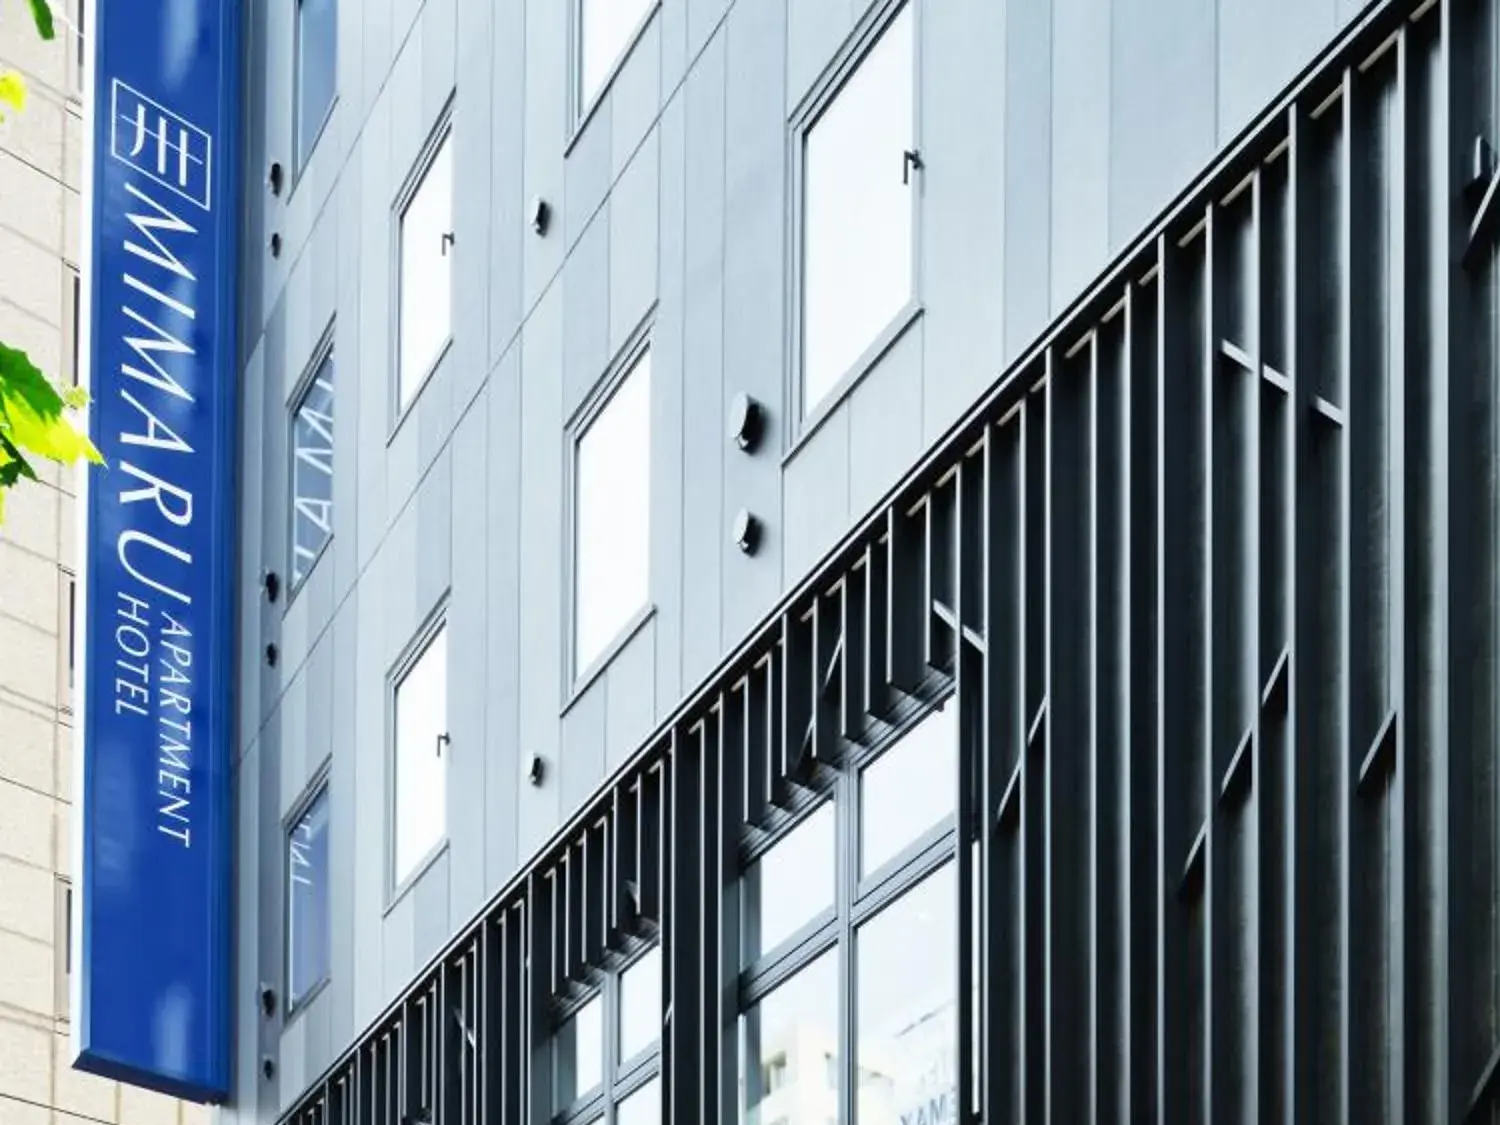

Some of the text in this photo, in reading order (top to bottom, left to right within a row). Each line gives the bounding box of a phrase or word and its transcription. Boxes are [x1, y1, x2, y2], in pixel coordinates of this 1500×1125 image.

[117, 181, 199, 604] MIMARU
[115, 591, 149, 716] HOTEL
[158, 611, 192, 848] APARTMENT
